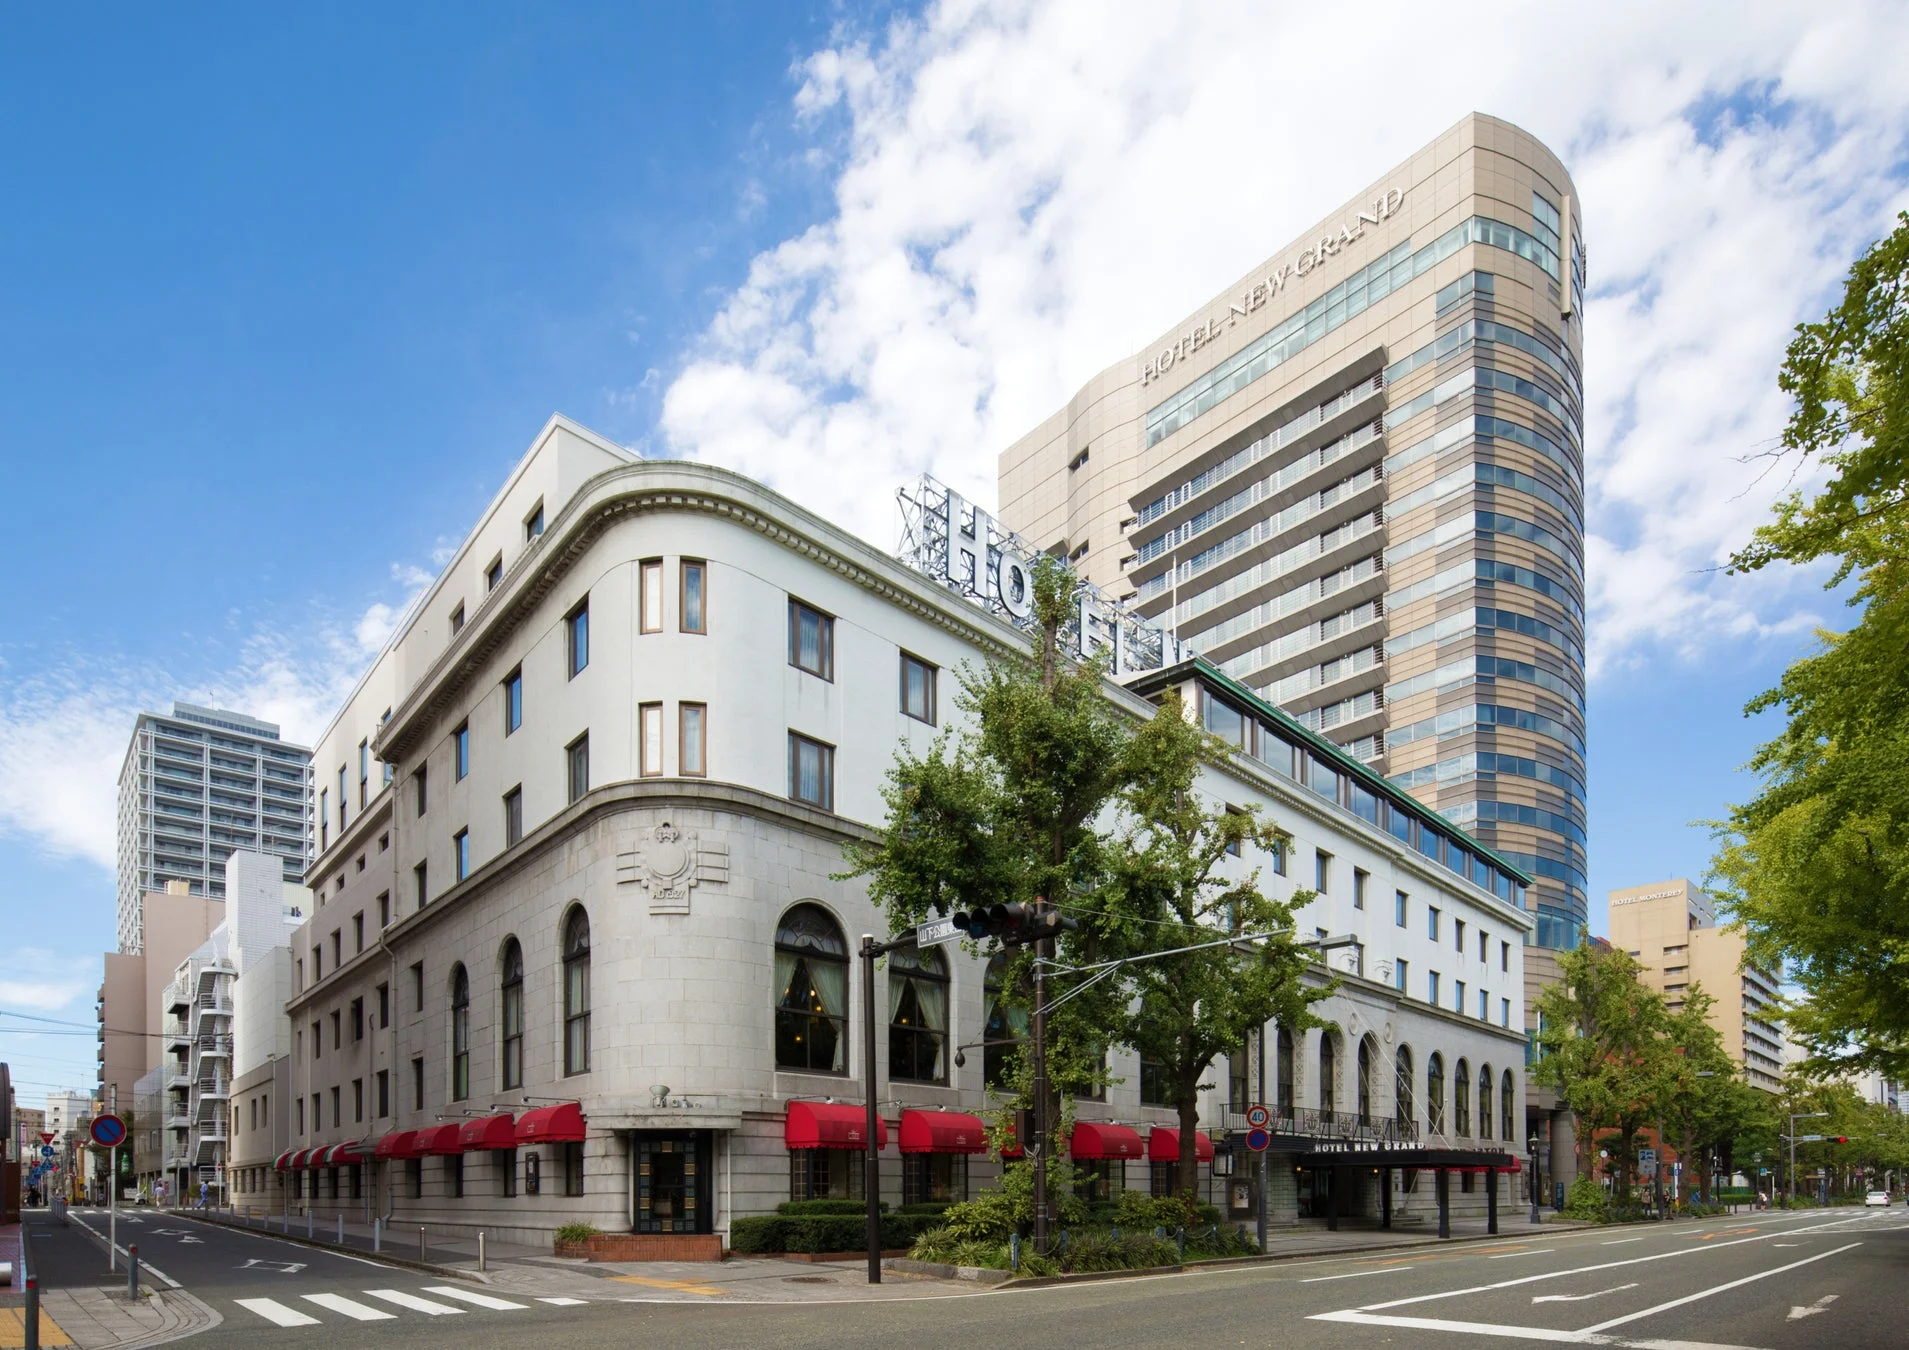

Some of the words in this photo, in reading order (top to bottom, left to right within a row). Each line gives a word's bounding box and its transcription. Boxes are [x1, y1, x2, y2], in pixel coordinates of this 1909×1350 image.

[1142, 318, 1222, 386] HOTEL
[1227, 264, 1290, 327] NEW
[1294, 186, 1404, 277] GRAND
[946, 487, 1133, 677] HOEL
[1611, 896, 1638, 907] HOTEL
[1640, 888, 1683, 902] MONTEREY
[1252, 1111, 1264, 1122] 40
[1315, 1143, 1349, 1152] HOTEL
[1354, 1142, 1379, 1151] NEW
[1384, 1141, 1425, 1151] GRAND
